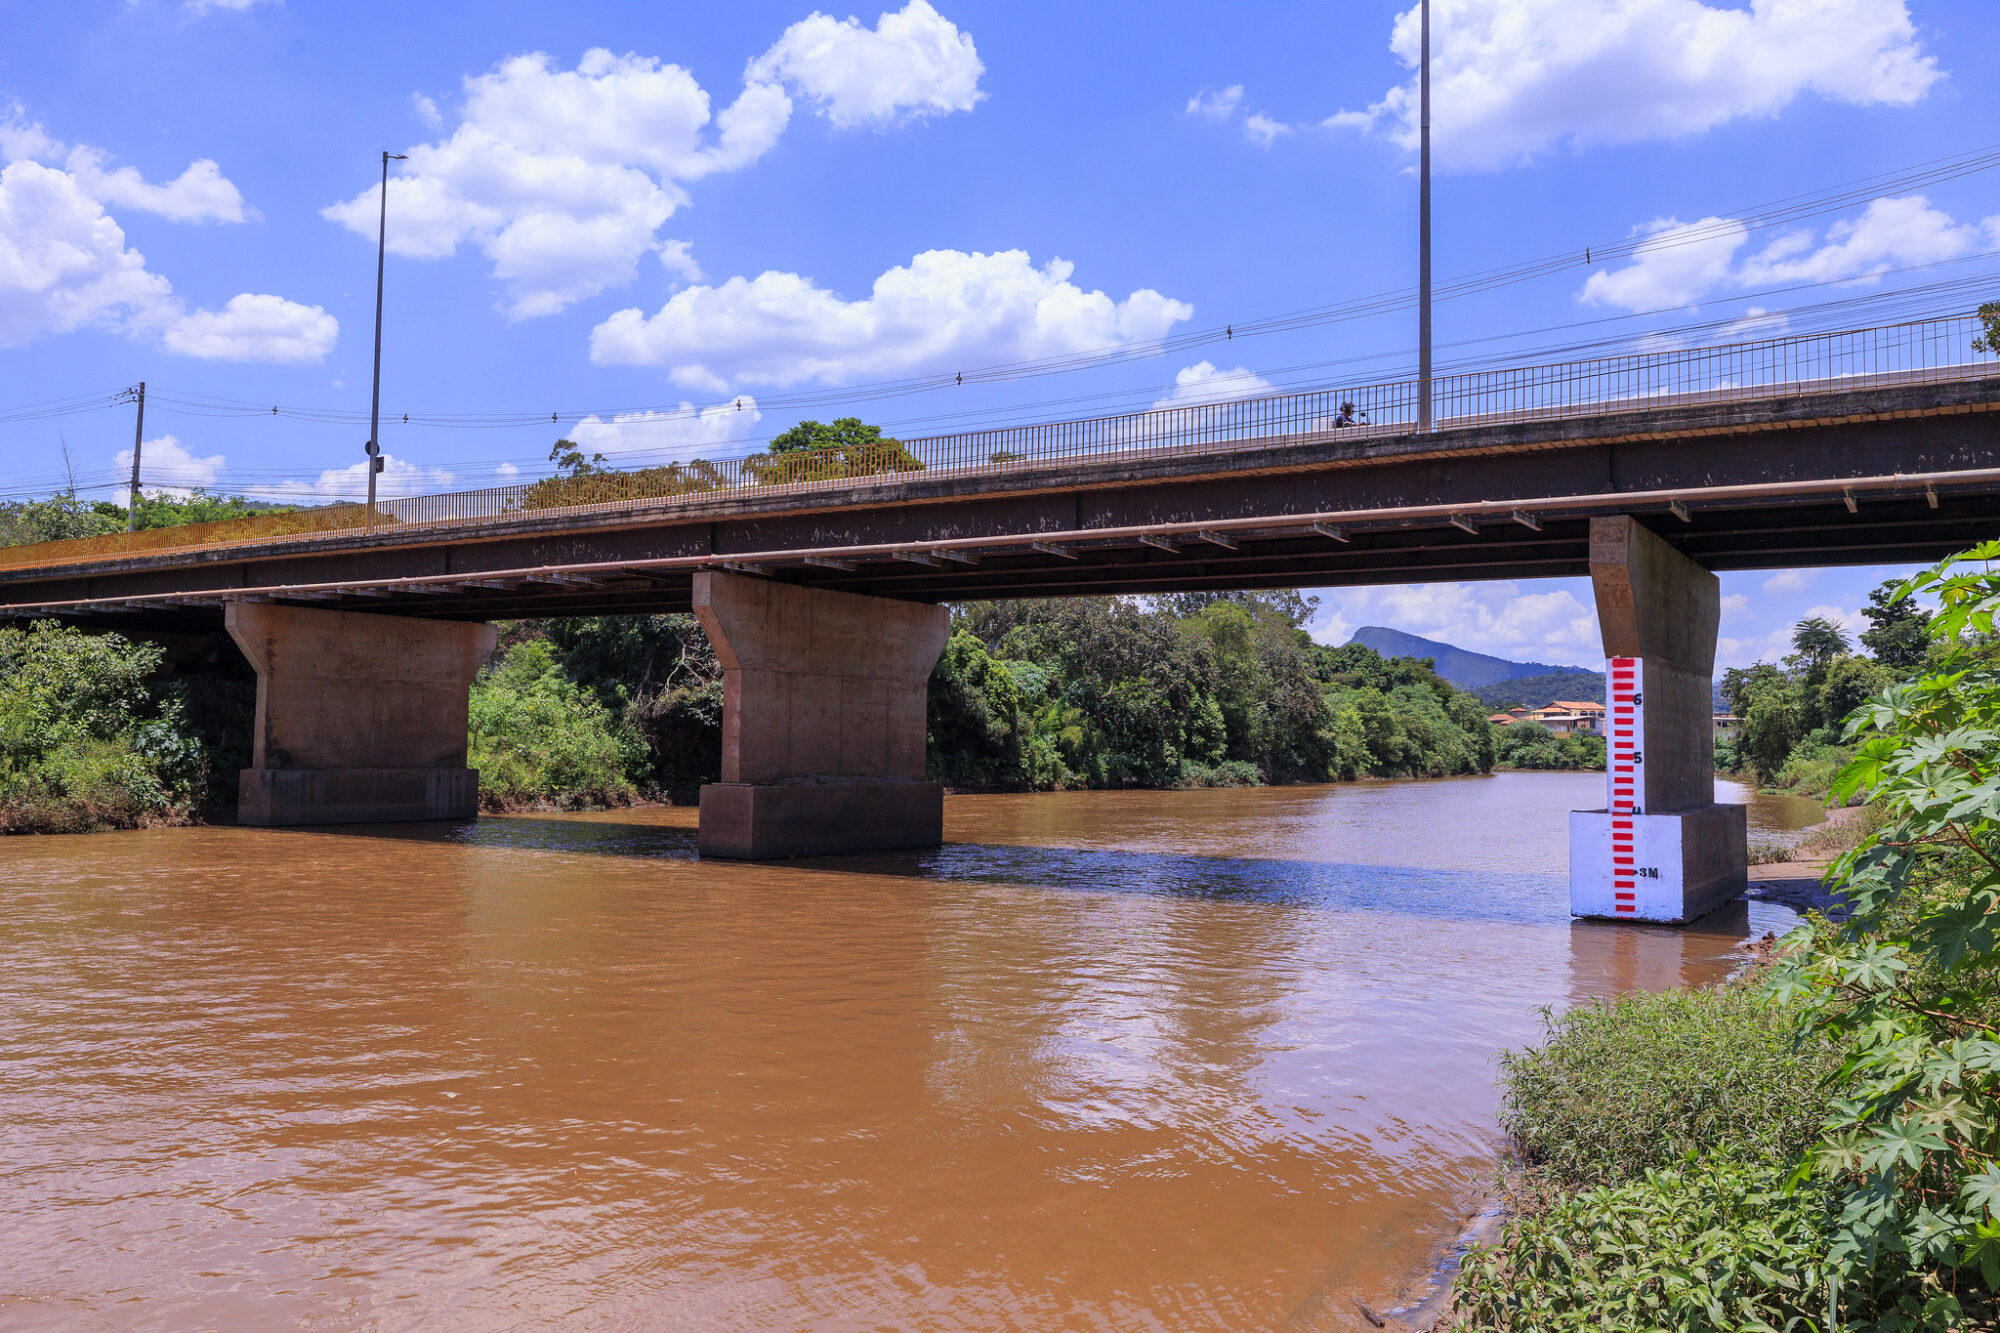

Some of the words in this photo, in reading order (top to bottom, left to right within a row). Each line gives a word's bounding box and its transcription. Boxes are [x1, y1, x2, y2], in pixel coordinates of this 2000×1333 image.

[1633, 693, 1642, 706] 6
[1633, 752, 1642, 764] 5
[1639, 867, 1658, 880] 3M
